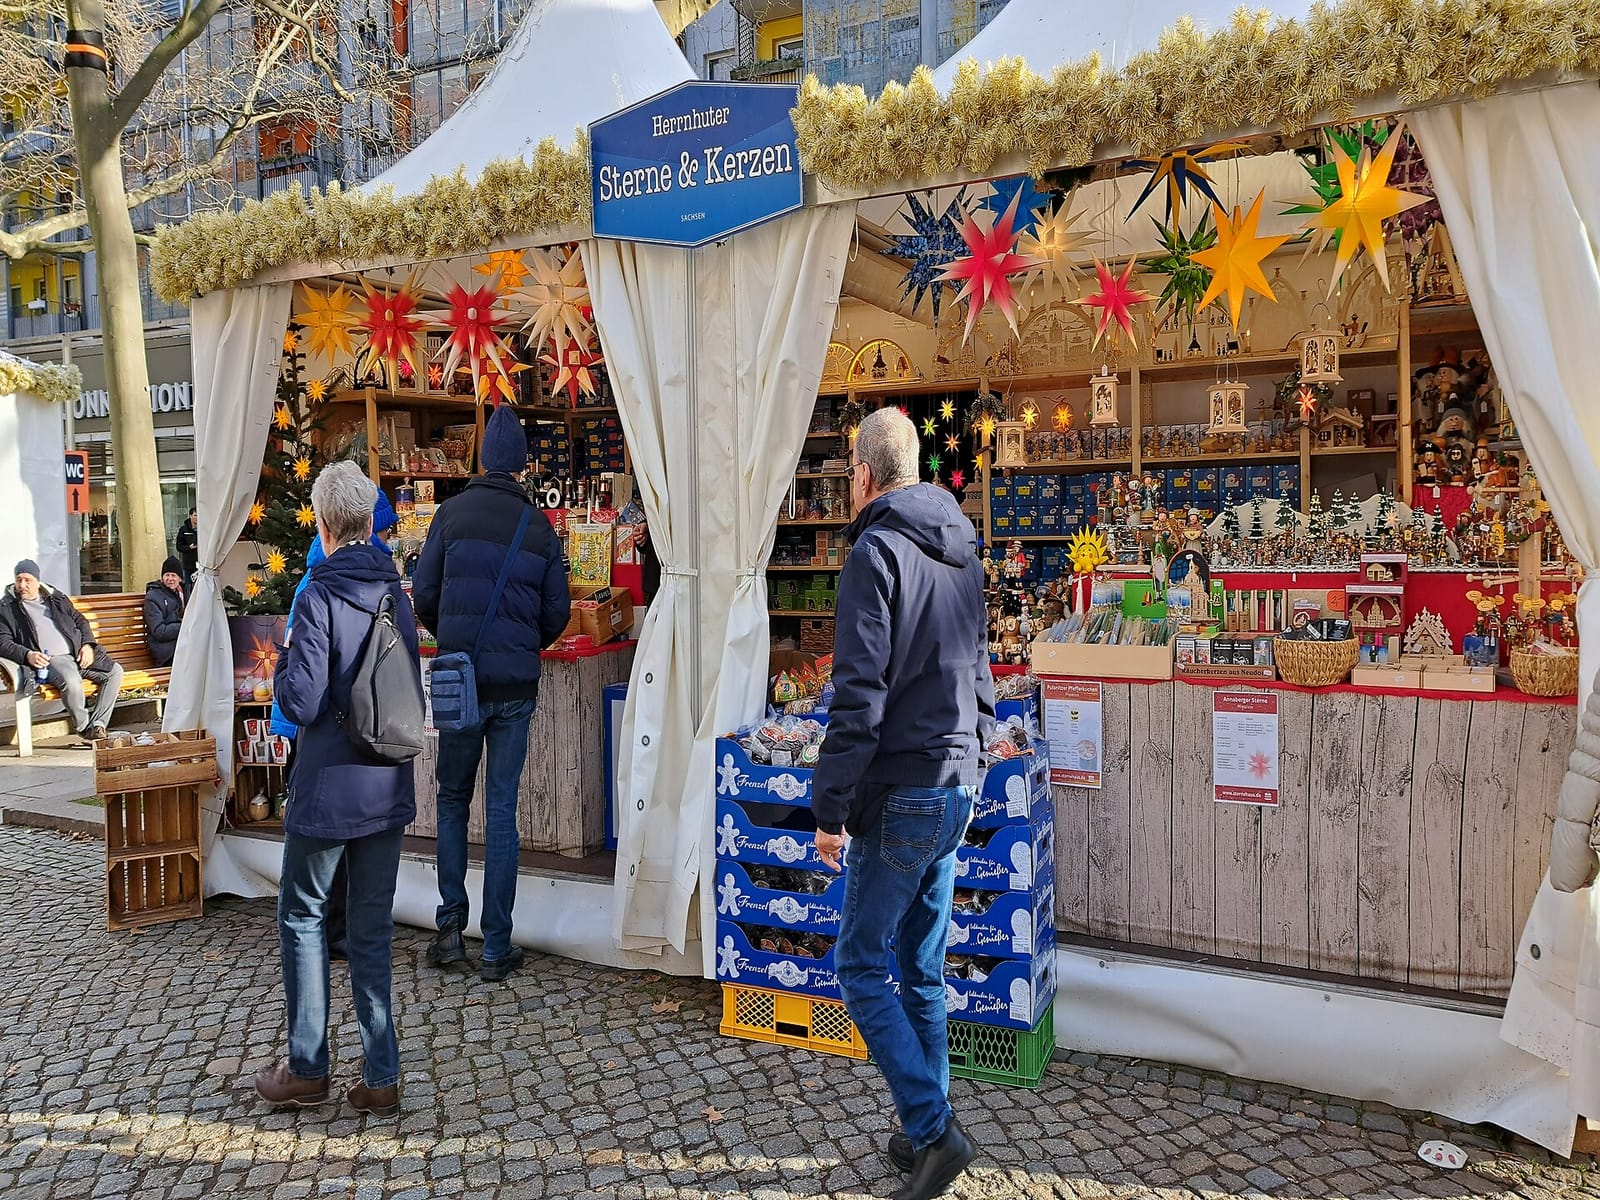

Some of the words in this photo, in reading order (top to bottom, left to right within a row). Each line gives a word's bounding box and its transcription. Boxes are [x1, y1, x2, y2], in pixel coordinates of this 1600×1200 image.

[652, 106, 730, 137] Herrnhuter
[600, 163, 672, 201] Sterne
[678, 151, 699, 189] &
[704, 142, 793, 185] Kerzen
[680, 212, 706, 222] SACHSEN
[66, 462, 84, 478] WC
[737, 774, 768, 789] Frenzel
[736, 835, 767, 851] Frenzel
[737, 895, 769, 911] Frenzel
[736, 958, 769, 975] Frenzel
